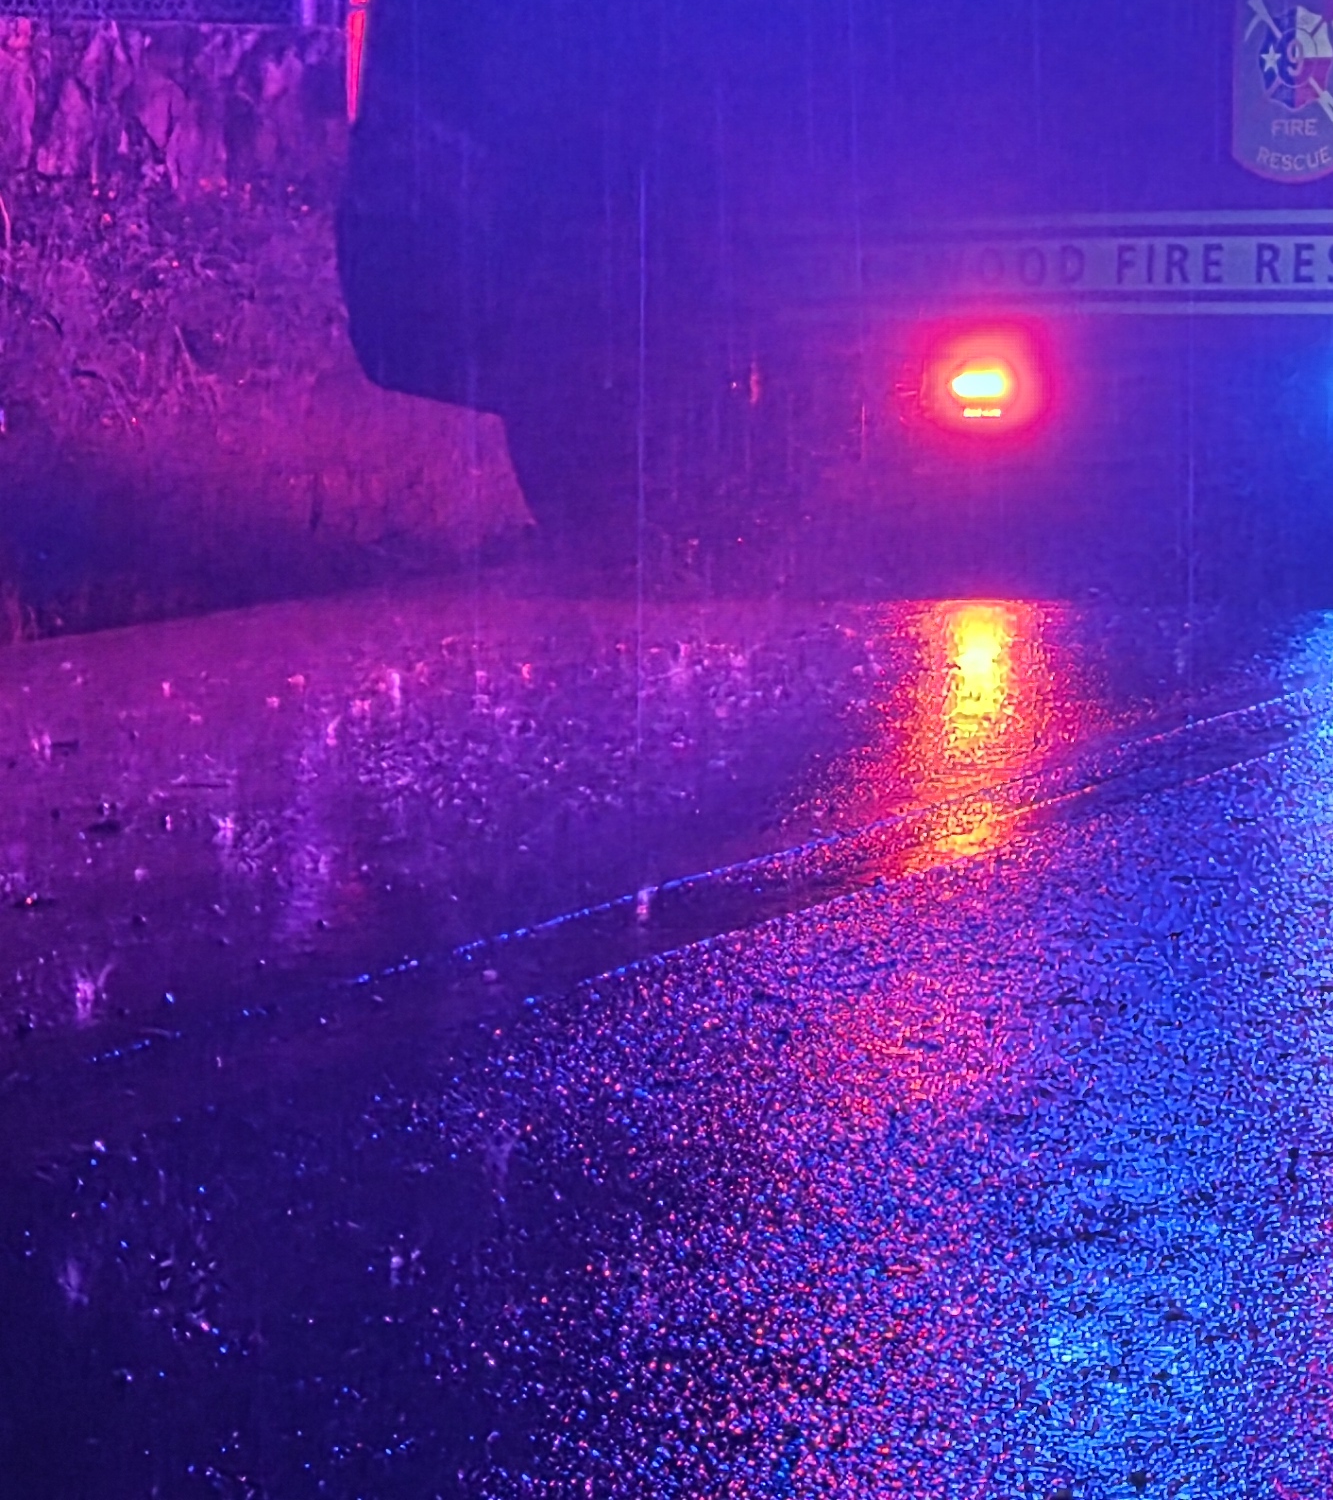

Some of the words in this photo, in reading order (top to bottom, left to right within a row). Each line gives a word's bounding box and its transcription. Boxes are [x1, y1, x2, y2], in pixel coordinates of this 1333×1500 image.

[1286, 39, 1304, 78] 9
[1270, 117, 1319, 138] FIRE
[1256, 145, 1333, 172] RESCUE
[1115, 242, 1224, 285] FIRE
